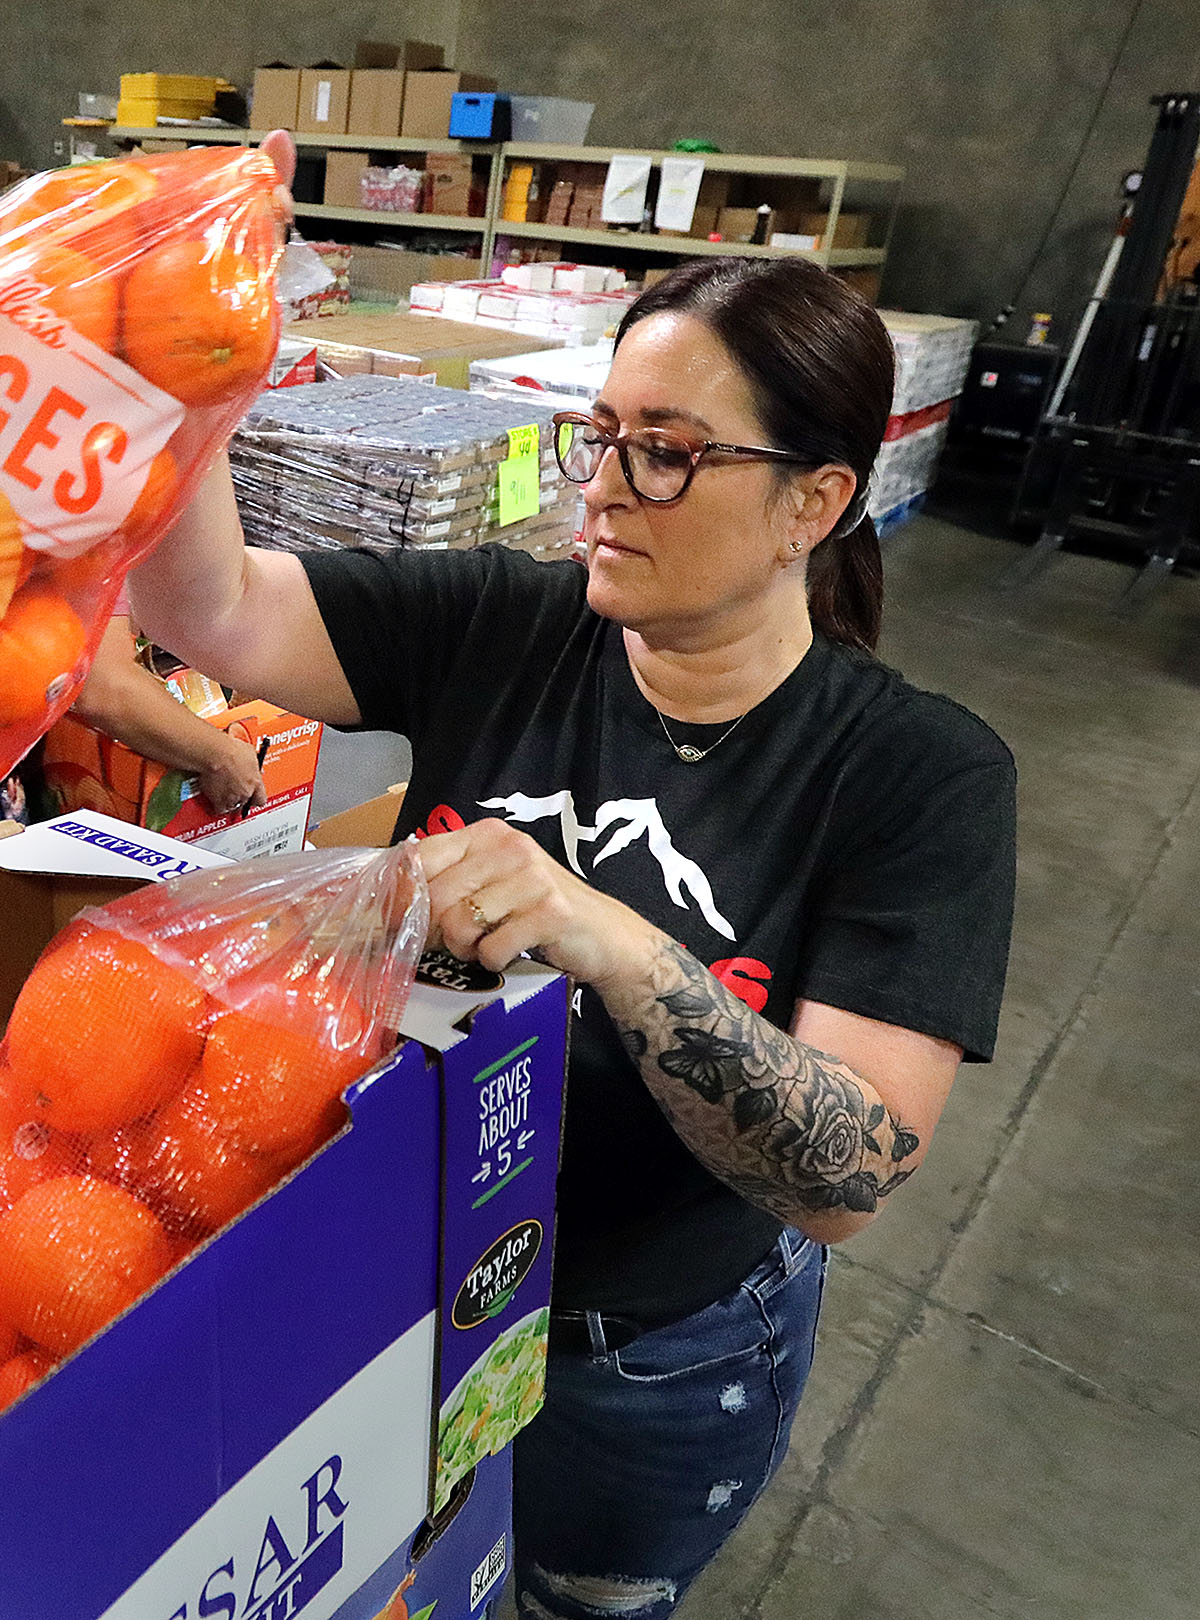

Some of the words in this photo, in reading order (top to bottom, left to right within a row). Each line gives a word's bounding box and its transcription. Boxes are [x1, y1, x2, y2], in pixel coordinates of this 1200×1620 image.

[55, 823, 97, 841] KIT
[197, 817, 227, 835] APPLES
[94, 834, 167, 865] SALAD
[479, 1056, 532, 1120] SERVES
[478, 1089, 531, 1156] ABOUT
[497, 1139, 511, 1176] 5
[466, 1228, 532, 1299] Taylor
[480, 1265, 518, 1310] FARMS
[169, 1454, 350, 1620] SAR
